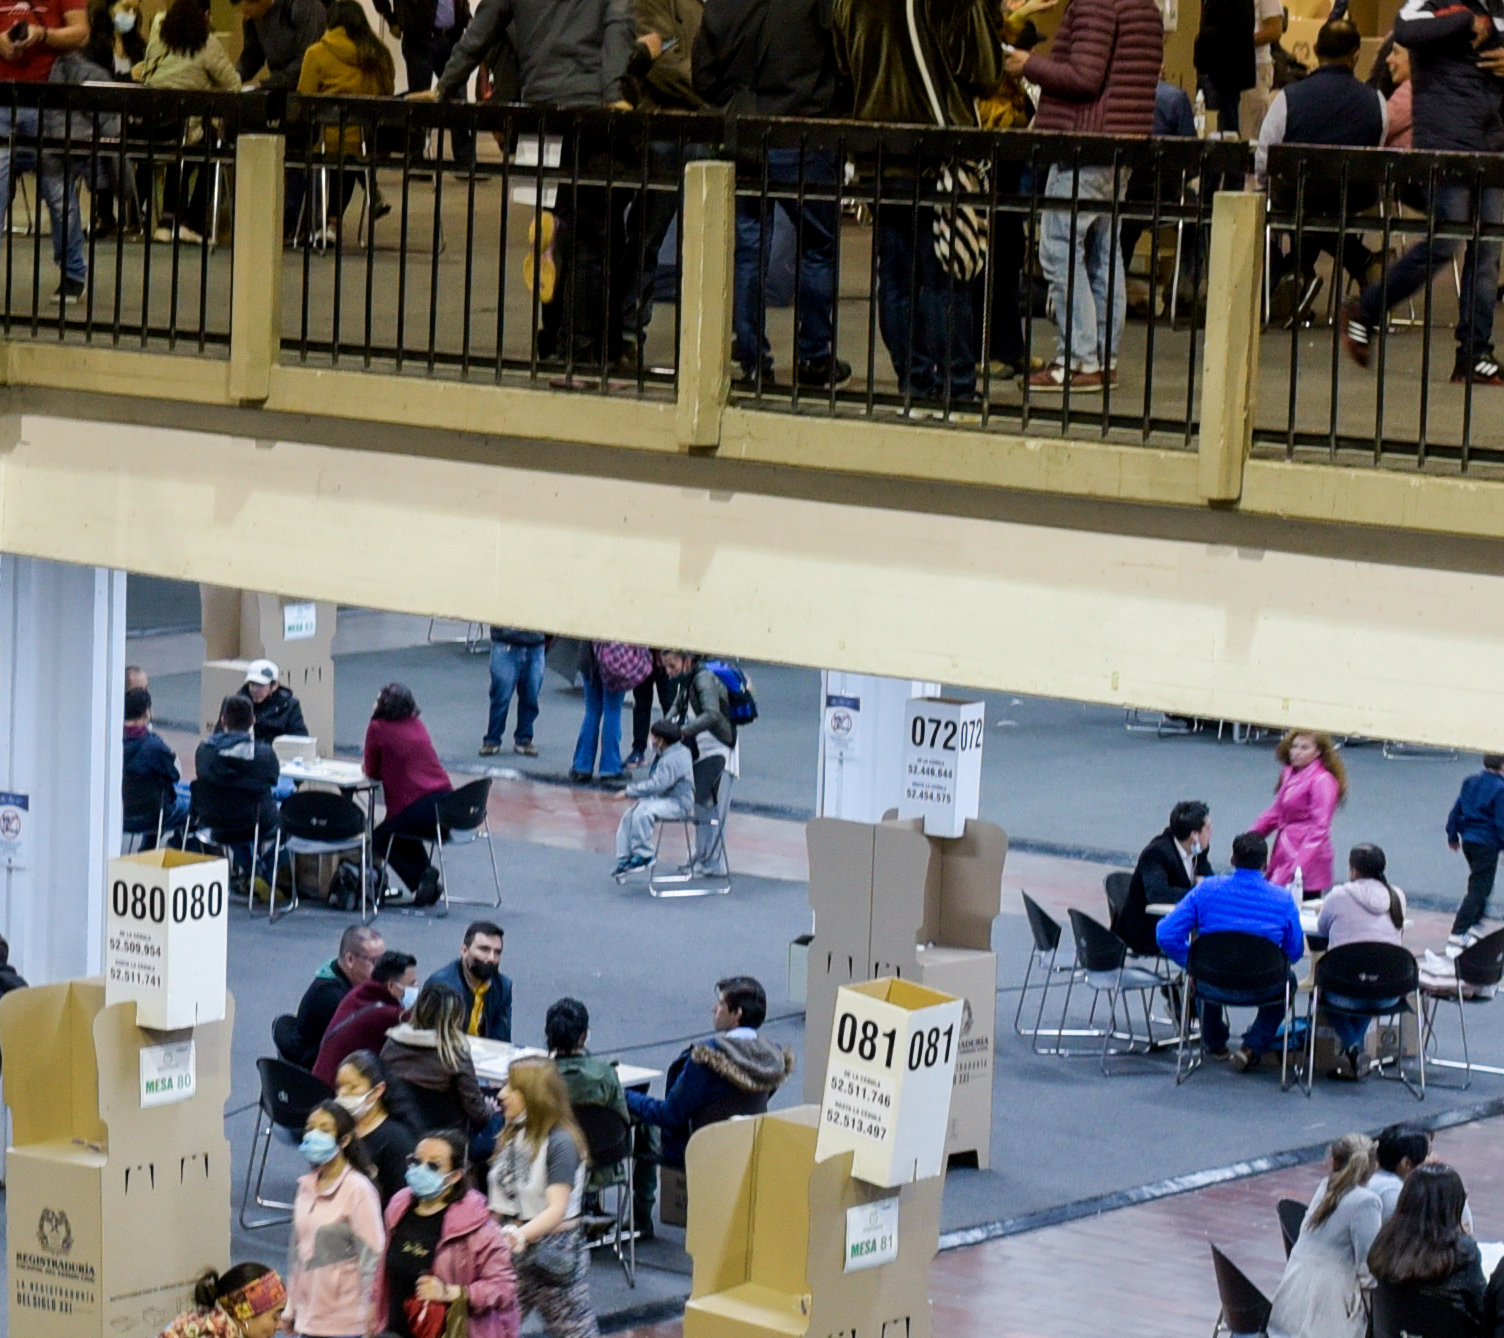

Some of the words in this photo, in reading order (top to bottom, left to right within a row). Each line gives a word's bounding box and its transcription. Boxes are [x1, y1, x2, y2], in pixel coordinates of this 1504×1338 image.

[911, 715, 958, 752] 072
[960, 717, 983, 752] 072
[112, 879, 166, 924] 080
[172, 881, 223, 924] 080
[837, 1012, 898, 1070] 081
[908, 1022, 954, 1072] 081
[145, 1076, 174, 1095] MESA
[177, 1072, 192, 1090] 80
[830, 1076, 892, 1109] 52.511.746
[826, 1108, 887, 1141] 52.513.497
[851, 1238, 877, 1259] MESA
[879, 1233, 894, 1251] 81
[16, 1252, 95, 1276] REGISTRADURÍA
[59, 1300, 73, 1315] XXI
